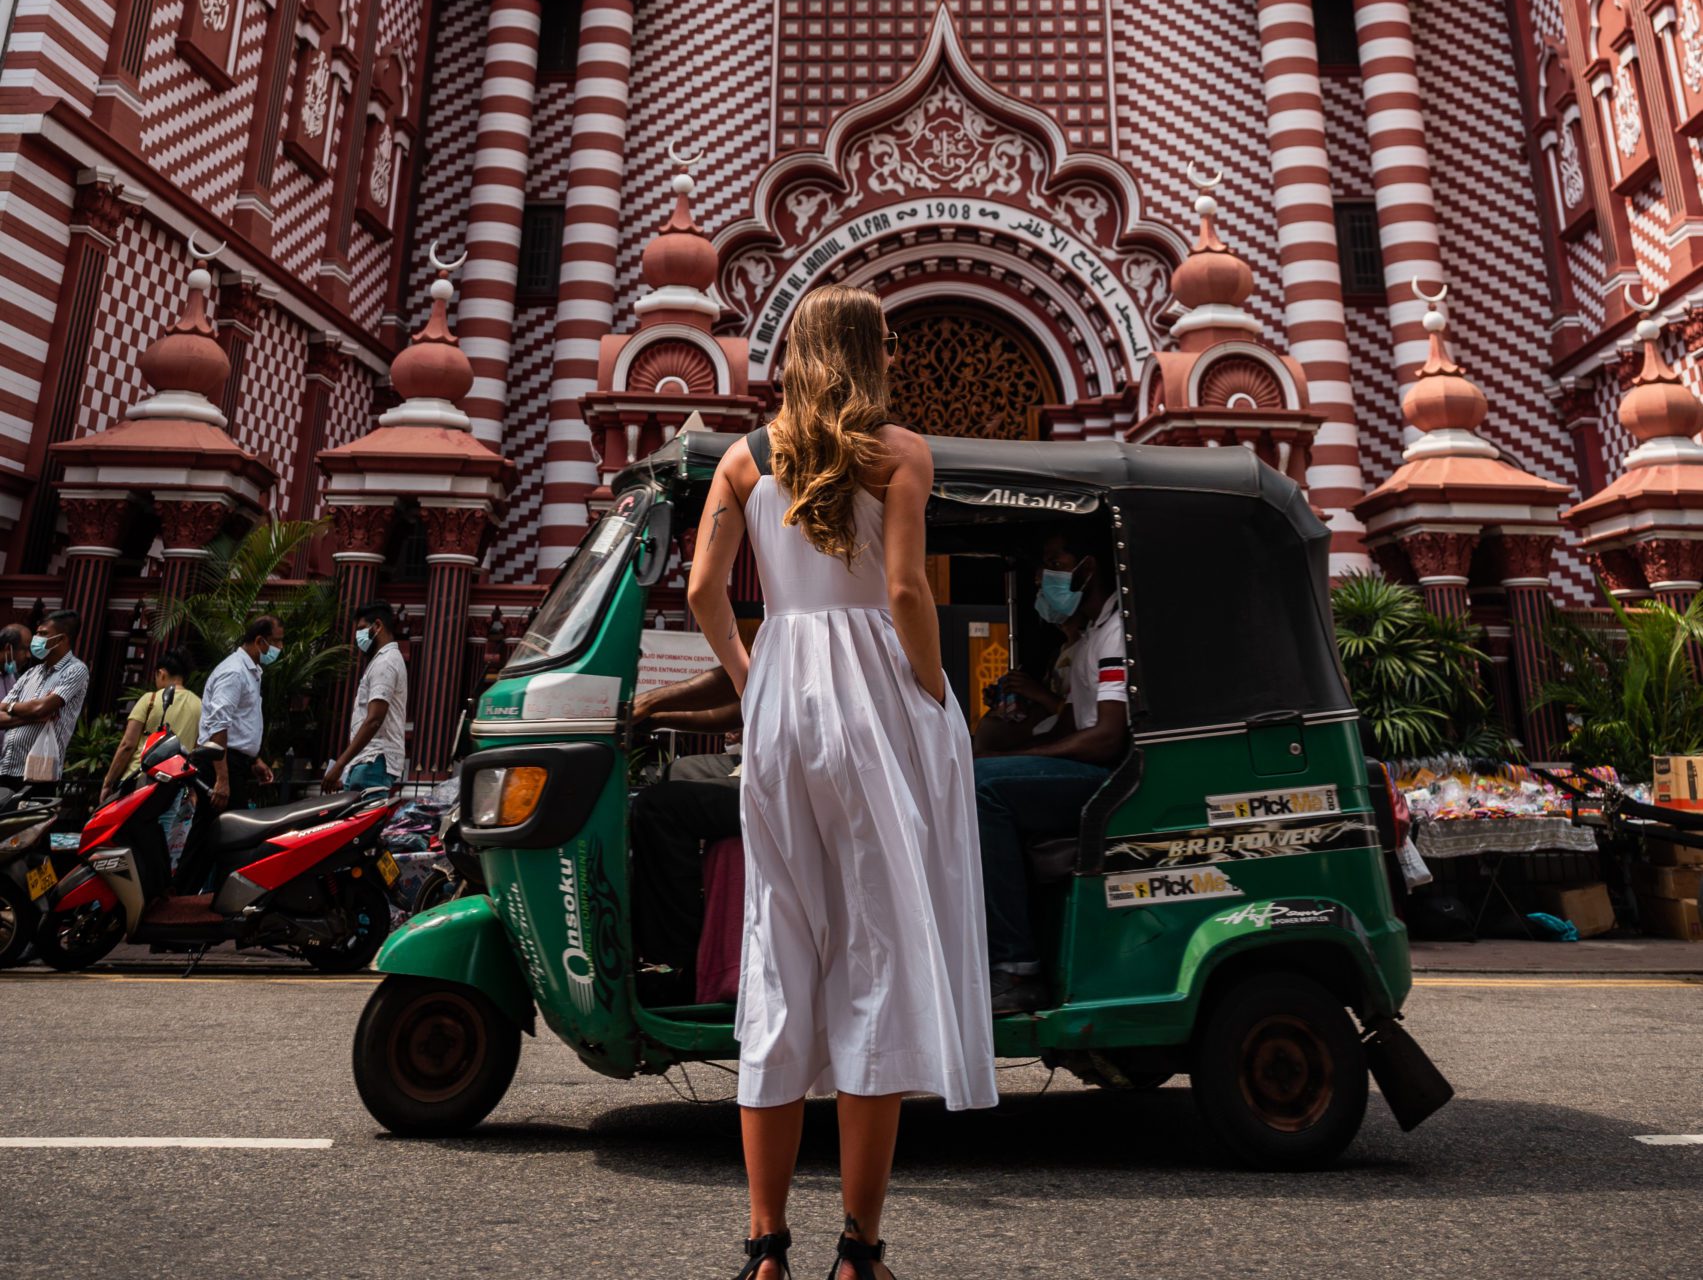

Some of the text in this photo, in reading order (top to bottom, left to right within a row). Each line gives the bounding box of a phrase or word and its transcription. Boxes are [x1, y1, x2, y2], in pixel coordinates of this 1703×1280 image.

[749, 202, 971, 365] AL MASJIDH AL JAMIUL ALFAR 1908
[980, 488, 1077, 511] Alitalia
[655, 653, 693, 661] INFORMATION
[559, 857, 595, 984] Onsoku
